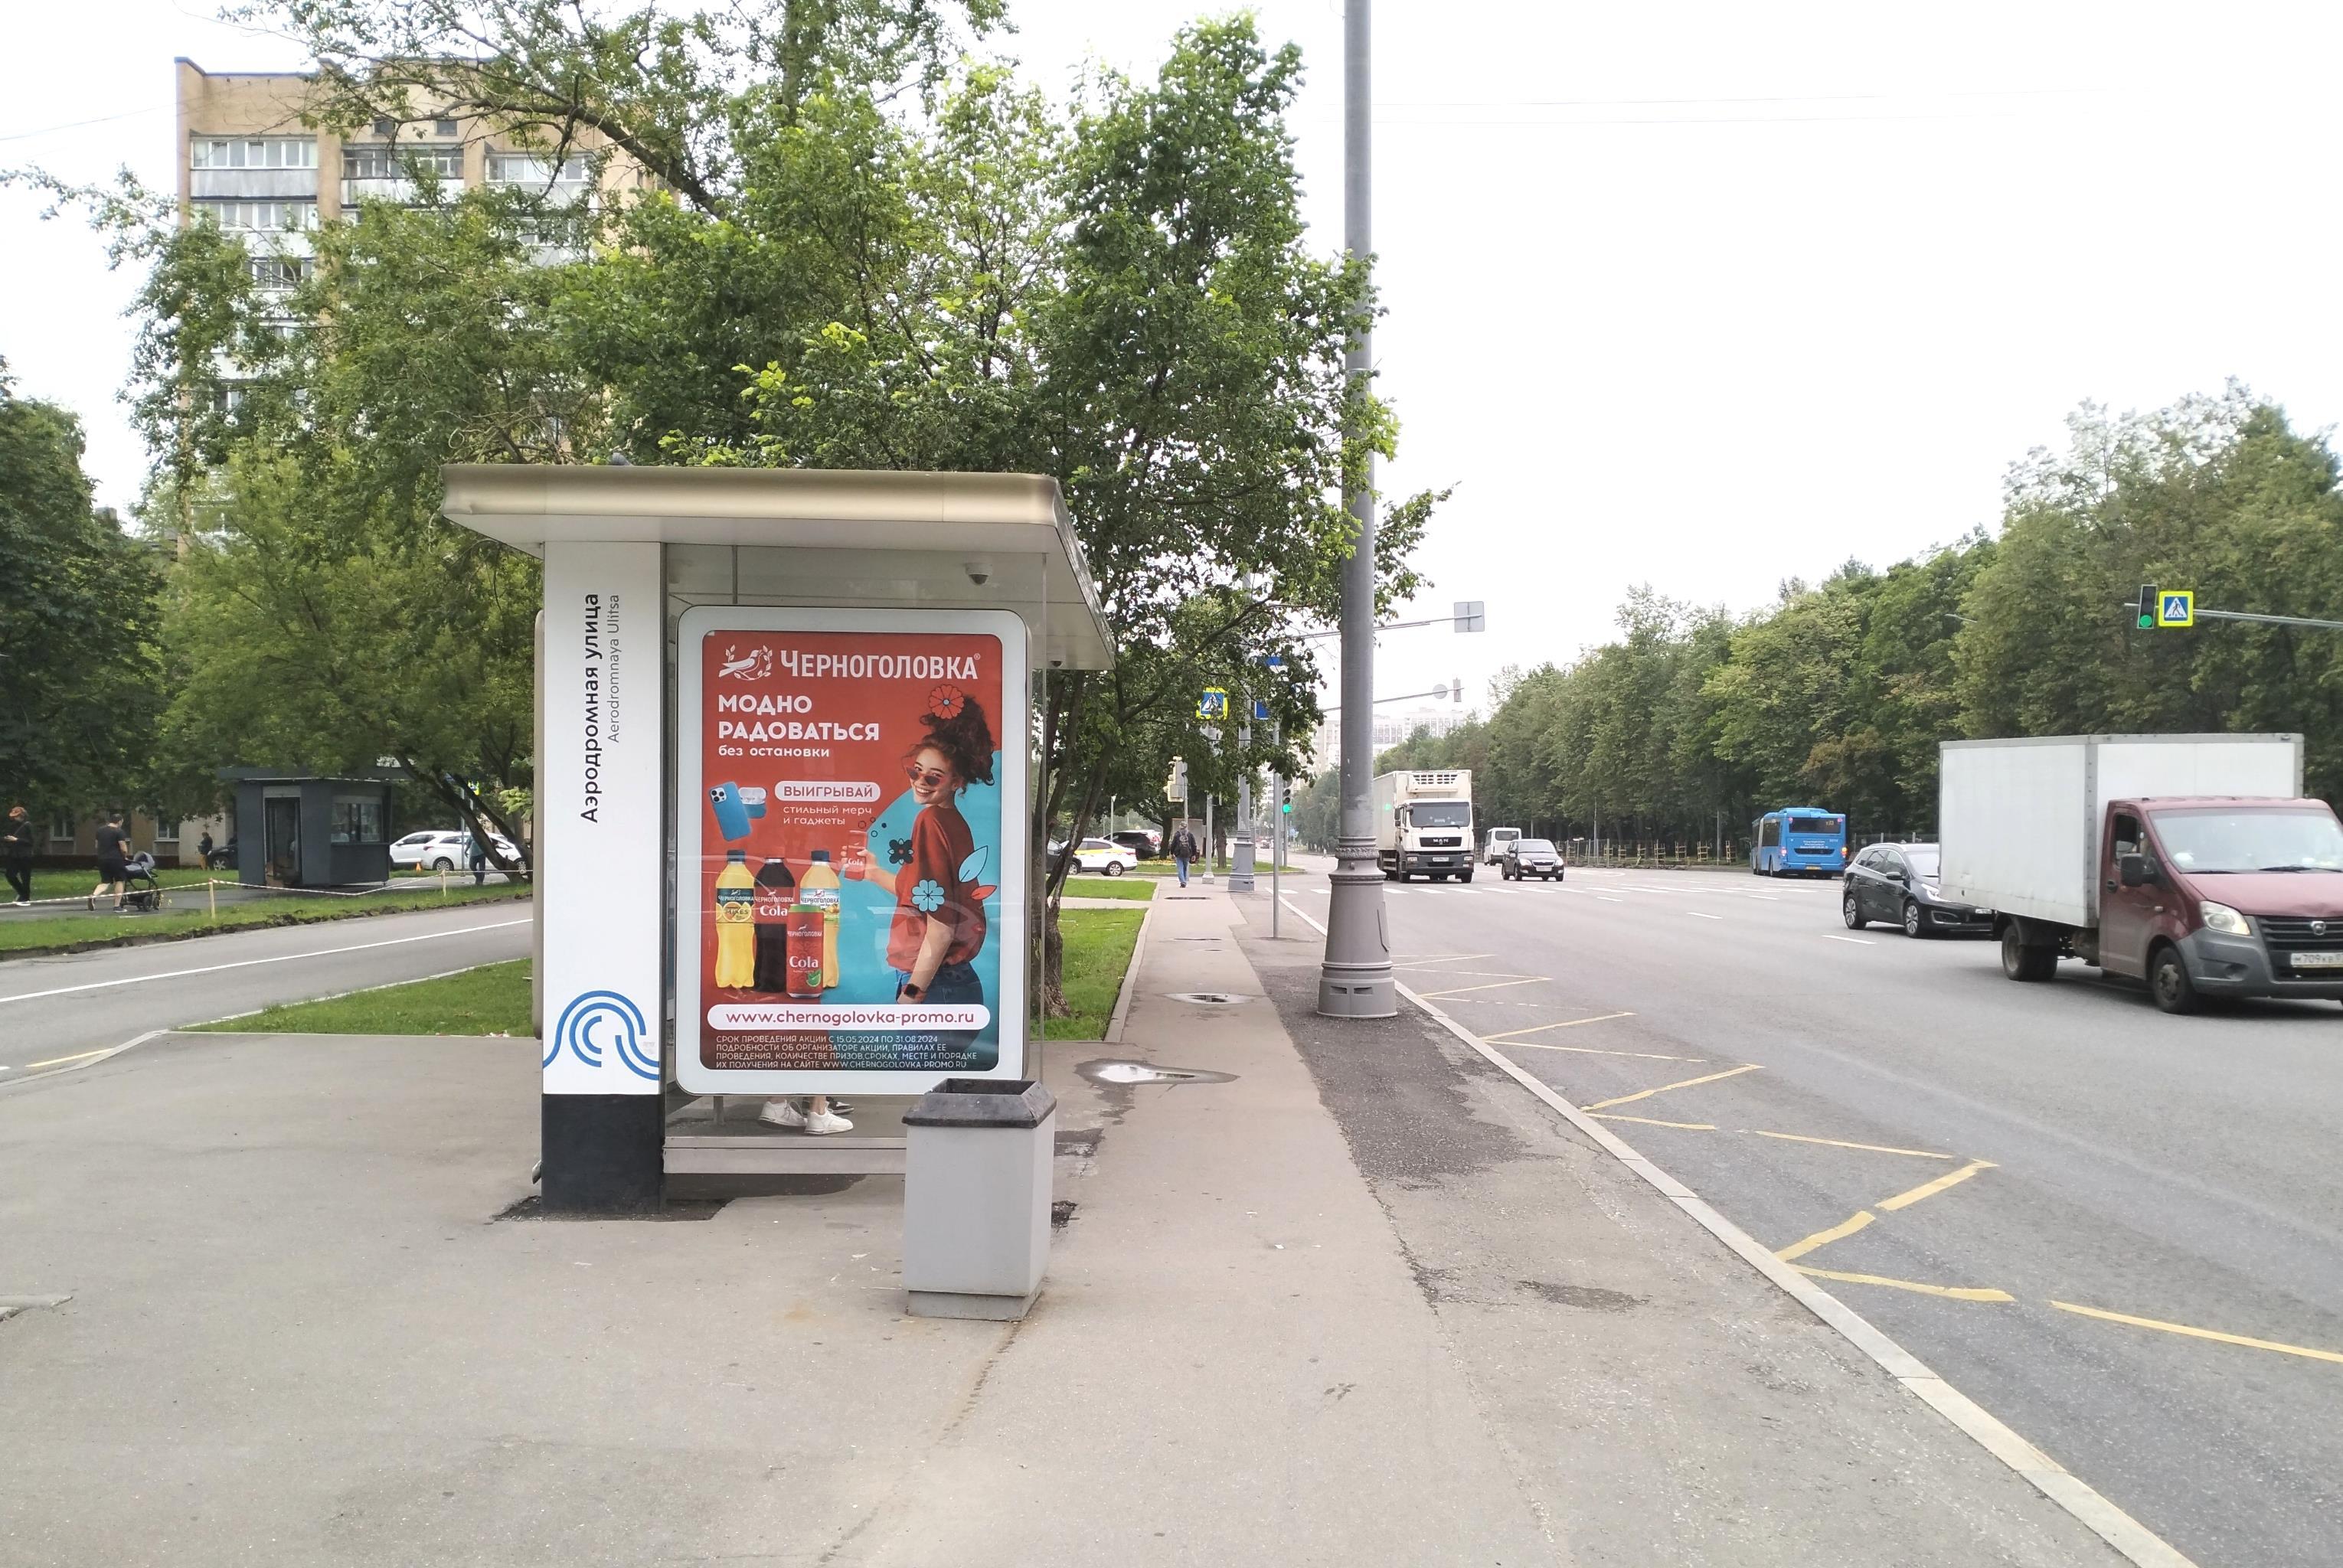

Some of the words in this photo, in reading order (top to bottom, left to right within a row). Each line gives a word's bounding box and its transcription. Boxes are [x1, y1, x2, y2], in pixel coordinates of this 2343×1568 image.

[606, 595, 619, 633] Ulitsa
[585, 594, 603, 659] улица
[606, 639, 622, 743] Aerodromnaya
[718, 694, 812, 715] МОДНО
[718, 721, 879, 742] РАДОВАТЬСЯ
[580, 668, 603, 823] Аэродромная
[718, 745, 743, 756] без
[750, 747, 829, 757] остановки
[783, 785, 873, 797] ВЫИГРЫВАЙ
[783, 805, 838, 814] стильный
[842, 807, 871, 815] мерч
[794, 817, 845, 825] гаджеты
[760, 905, 788, 916] Cola
[789, 956, 819, 968] Cola
[726, 1011, 975, 1027] www.chernogolovka-promo.ru
[799, 1035, 827, 1044] АКЦИИ
